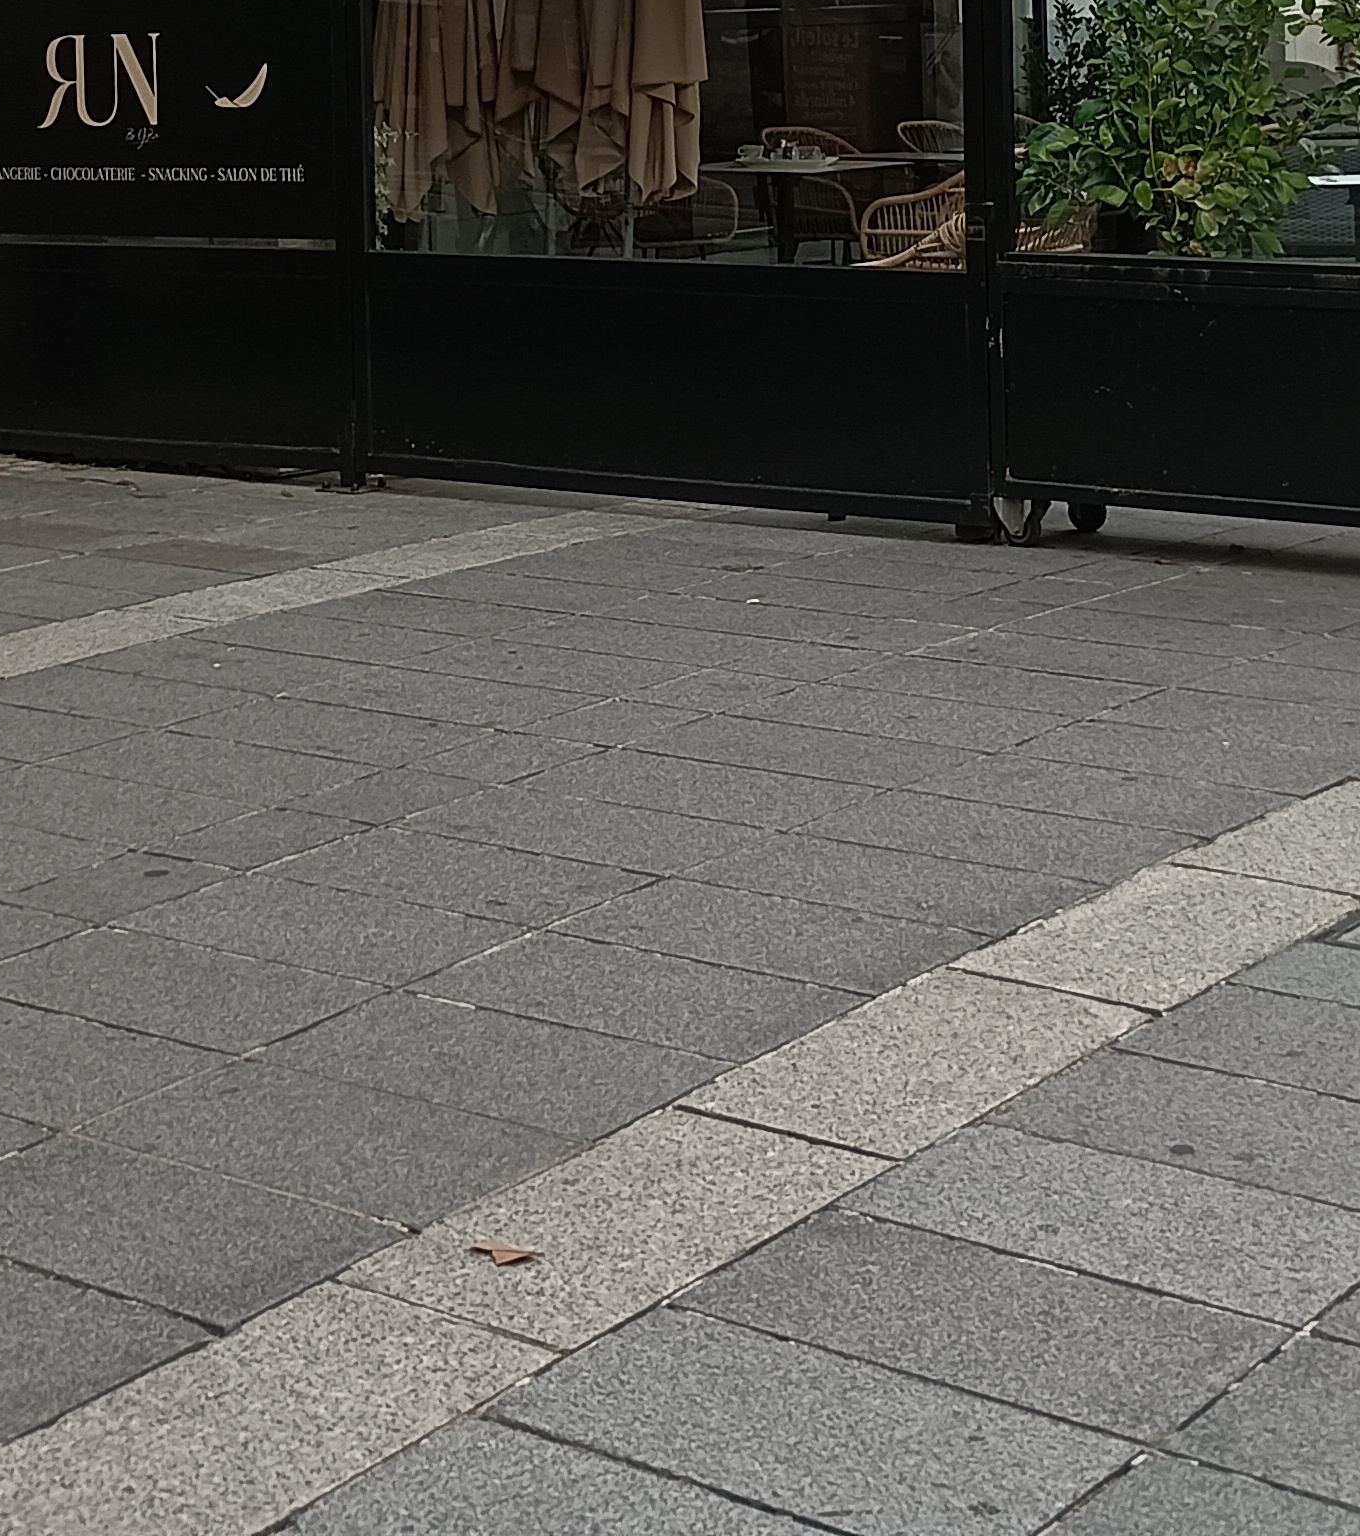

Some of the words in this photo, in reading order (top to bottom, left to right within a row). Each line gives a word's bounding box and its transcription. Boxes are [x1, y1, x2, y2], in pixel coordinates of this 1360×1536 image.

[50, 166, 136, 182] CHOCOLATERIE
[148, 167, 208, 182] SNACKING
[217, 167, 257, 182] SALON
[260, 167, 278, 182] DE
[279, 164, 305, 182] THÉ
